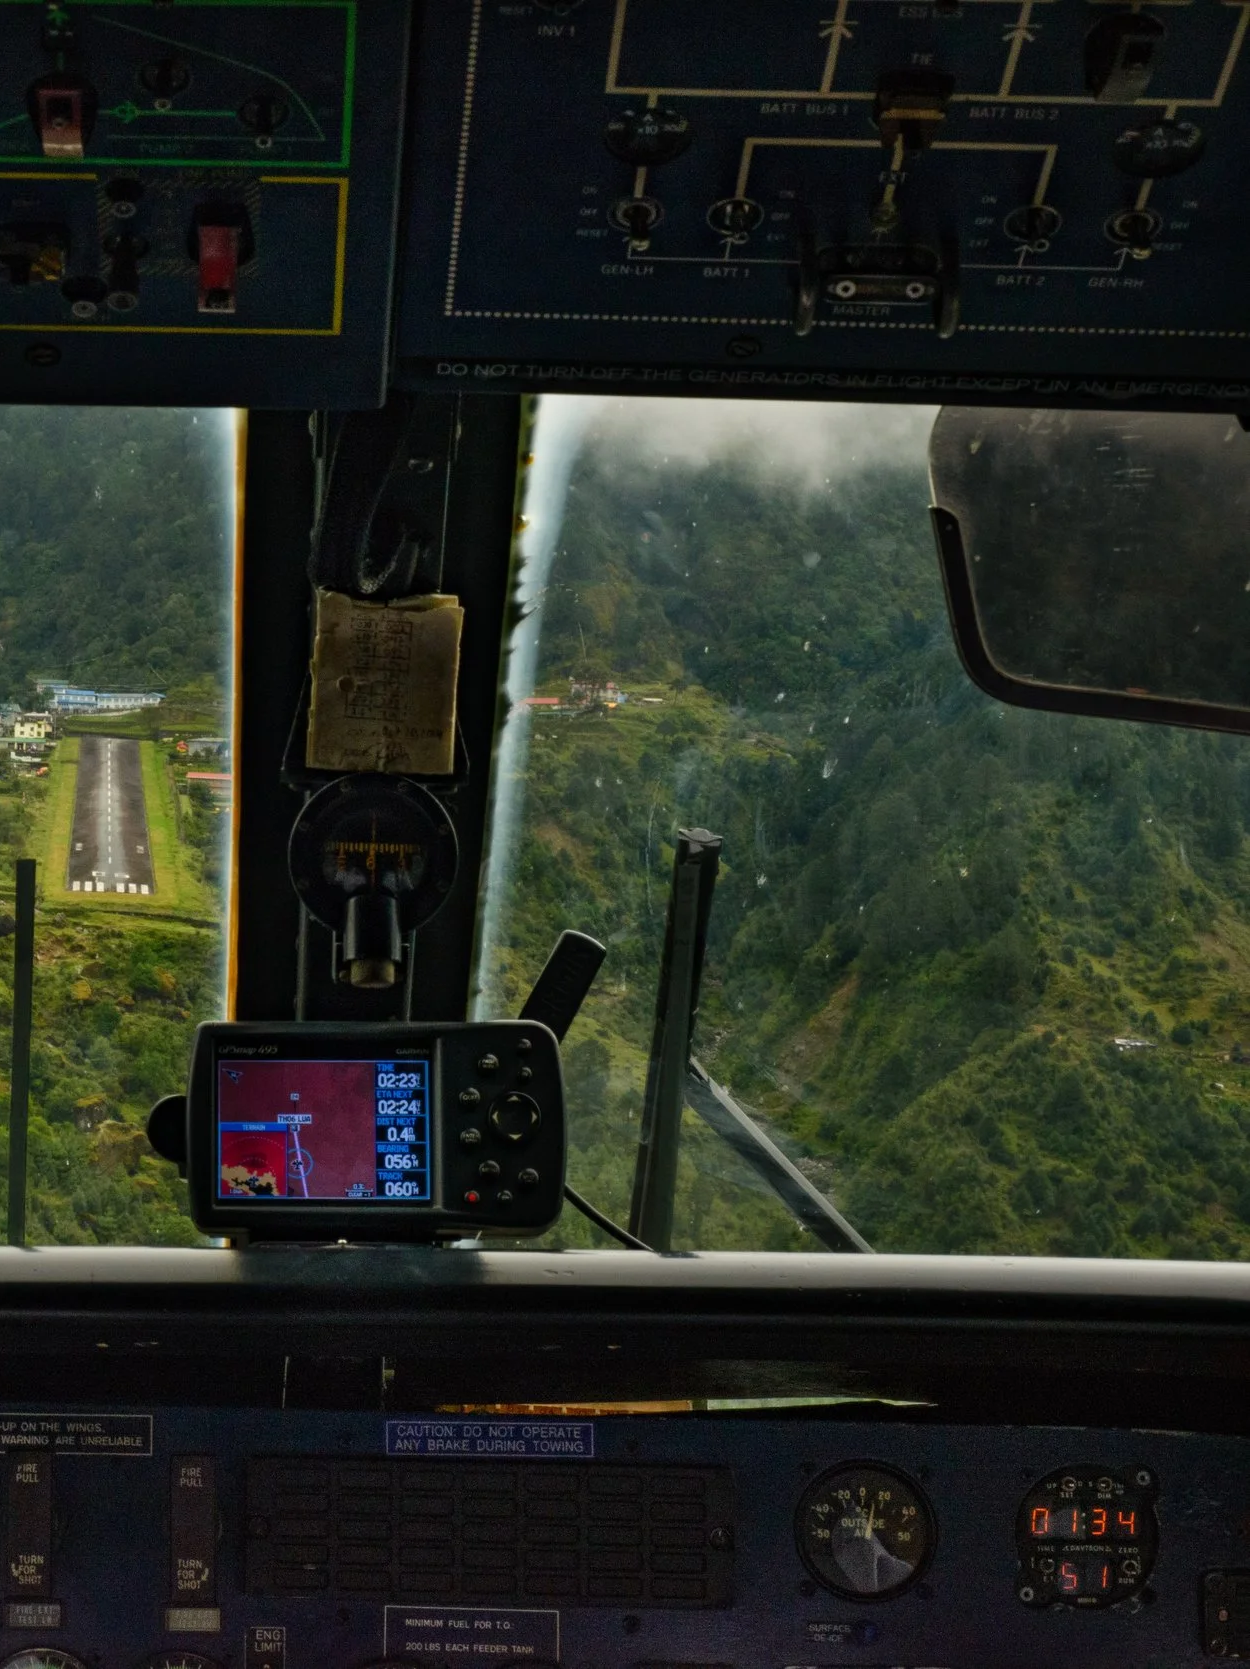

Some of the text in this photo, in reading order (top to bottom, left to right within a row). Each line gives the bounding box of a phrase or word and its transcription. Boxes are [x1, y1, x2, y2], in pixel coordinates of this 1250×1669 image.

[760, 103, 798, 115] BATT
[969, 106, 1008, 119] BATT
[1013, 107, 1045, 120] BUS
[601, 265, 654, 276] GEN-LH
[703, 267, 739, 278] BATT
[996, 275, 1032, 286] BATT
[1088, 277, 1145, 289] GEN-RH
[436, 362, 468, 377] DO
[473, 363, 518, 378] NOT
[527, 364, 586, 379] TURN
[590, 366, 634, 380] OFF
[641, 368, 685, 382] THE
[688, 369, 841, 387] GENERATORS
[377, 1063, 395, 1072] TIME
[376, 1090, 393, 1099] ETA
[20, 1422, 38, 1432] ON
[41, 1422, 60, 1433] THE
[396, 1425, 582, 1440] CAUTION: DO NOT OPERATE
[0, 1434, 50, 1445] WARNING
[55, 1435, 76, 1445] ARE
[80, 1435, 144, 1447] UNRELIABLE
[394, 1438, 585, 1453] ANY BRAKE DURING TOWING
[17, 1463, 39, 1474] FIRE
[181, 1467, 202, 1478] FIRE
[15, 1473, 39, 1483] PULL
[179, 1478, 204, 1488] PULL
[1031, 1507, 1136, 1536] 01:34
[897, 1531, 912, 1542] 50
[18, 1555, 45, 1564] TURN
[177, 1559, 203, 1569] TURN
[18, 1565, 36, 1575] FOR
[177, 1570, 195, 1580] FOR
[1061, 1561, 1109, 1590] 51
[18, 1575, 43, 1585] SHOT
[176, 1580, 202, 1590] SHOT
[405, 1618, 443, 1628] MINIMUM
[448, 1619, 470, 1629] FUEL
[474, 1620, 492, 1629] FOR
[255, 1629, 281, 1640] ENG
[254, 1641, 283, 1652] LIMIT
[405, 1642, 534, 1654] 200 LBS EACH FEEDER TANK
